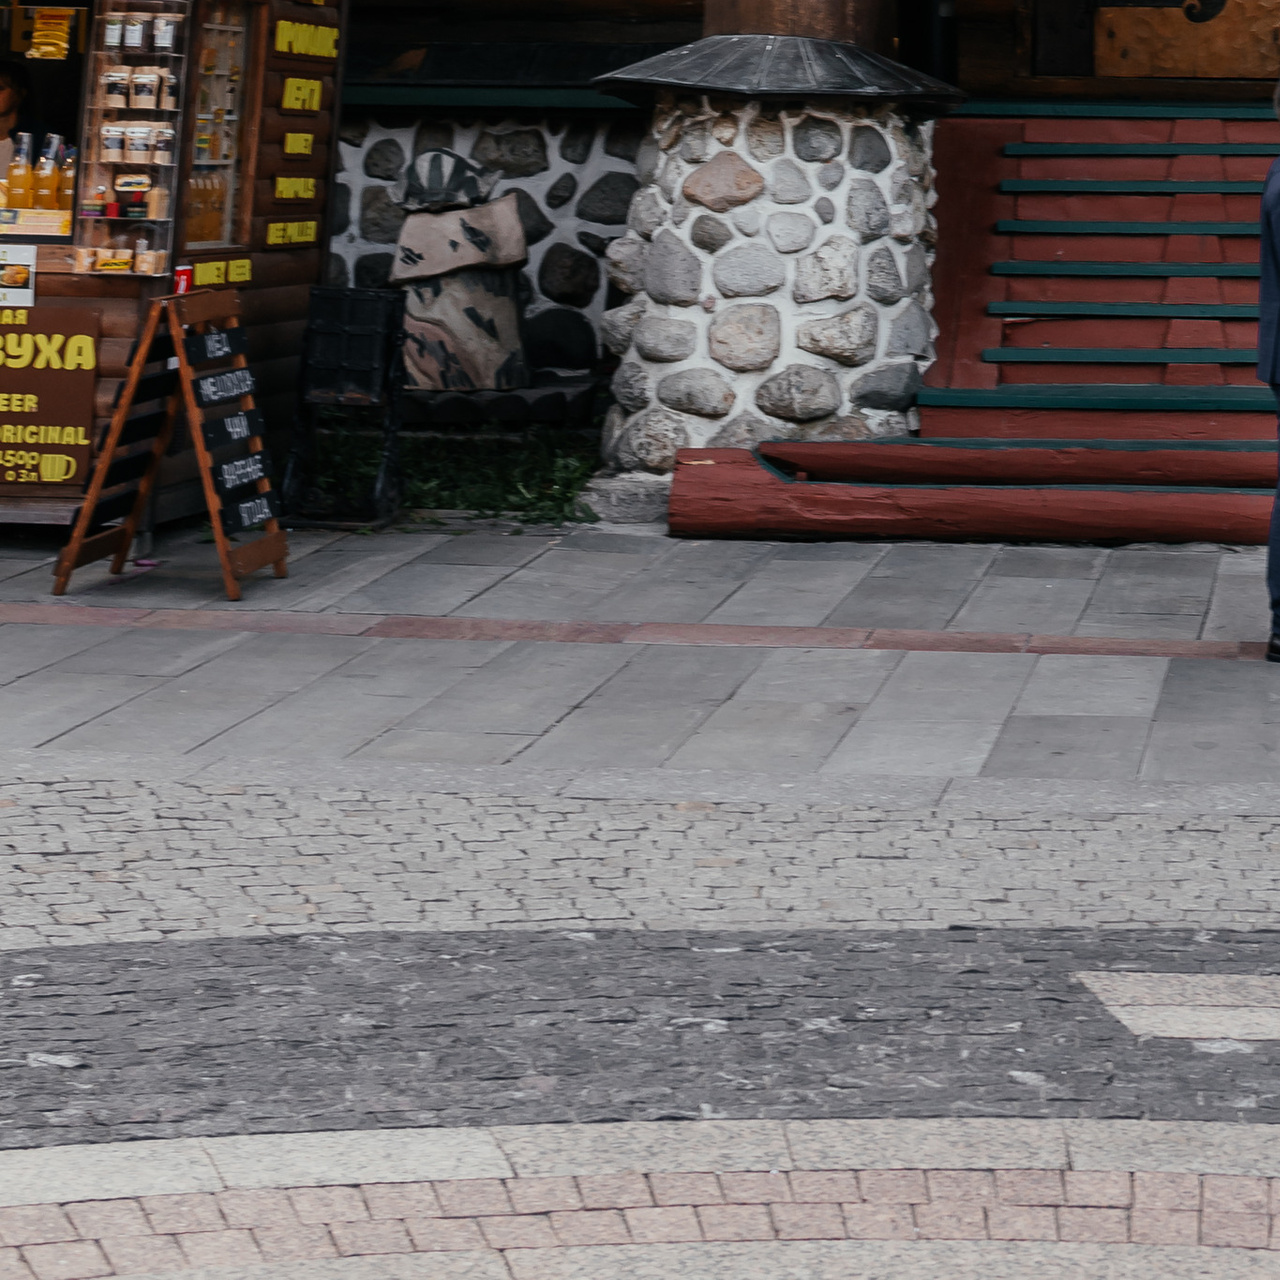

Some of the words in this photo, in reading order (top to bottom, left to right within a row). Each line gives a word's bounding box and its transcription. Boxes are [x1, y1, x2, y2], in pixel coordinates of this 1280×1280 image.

[0, 309, 28, 325] АЯ
[0, 333, 96, 371] УХА
[0, 424, 91, 445] RIGINAL
